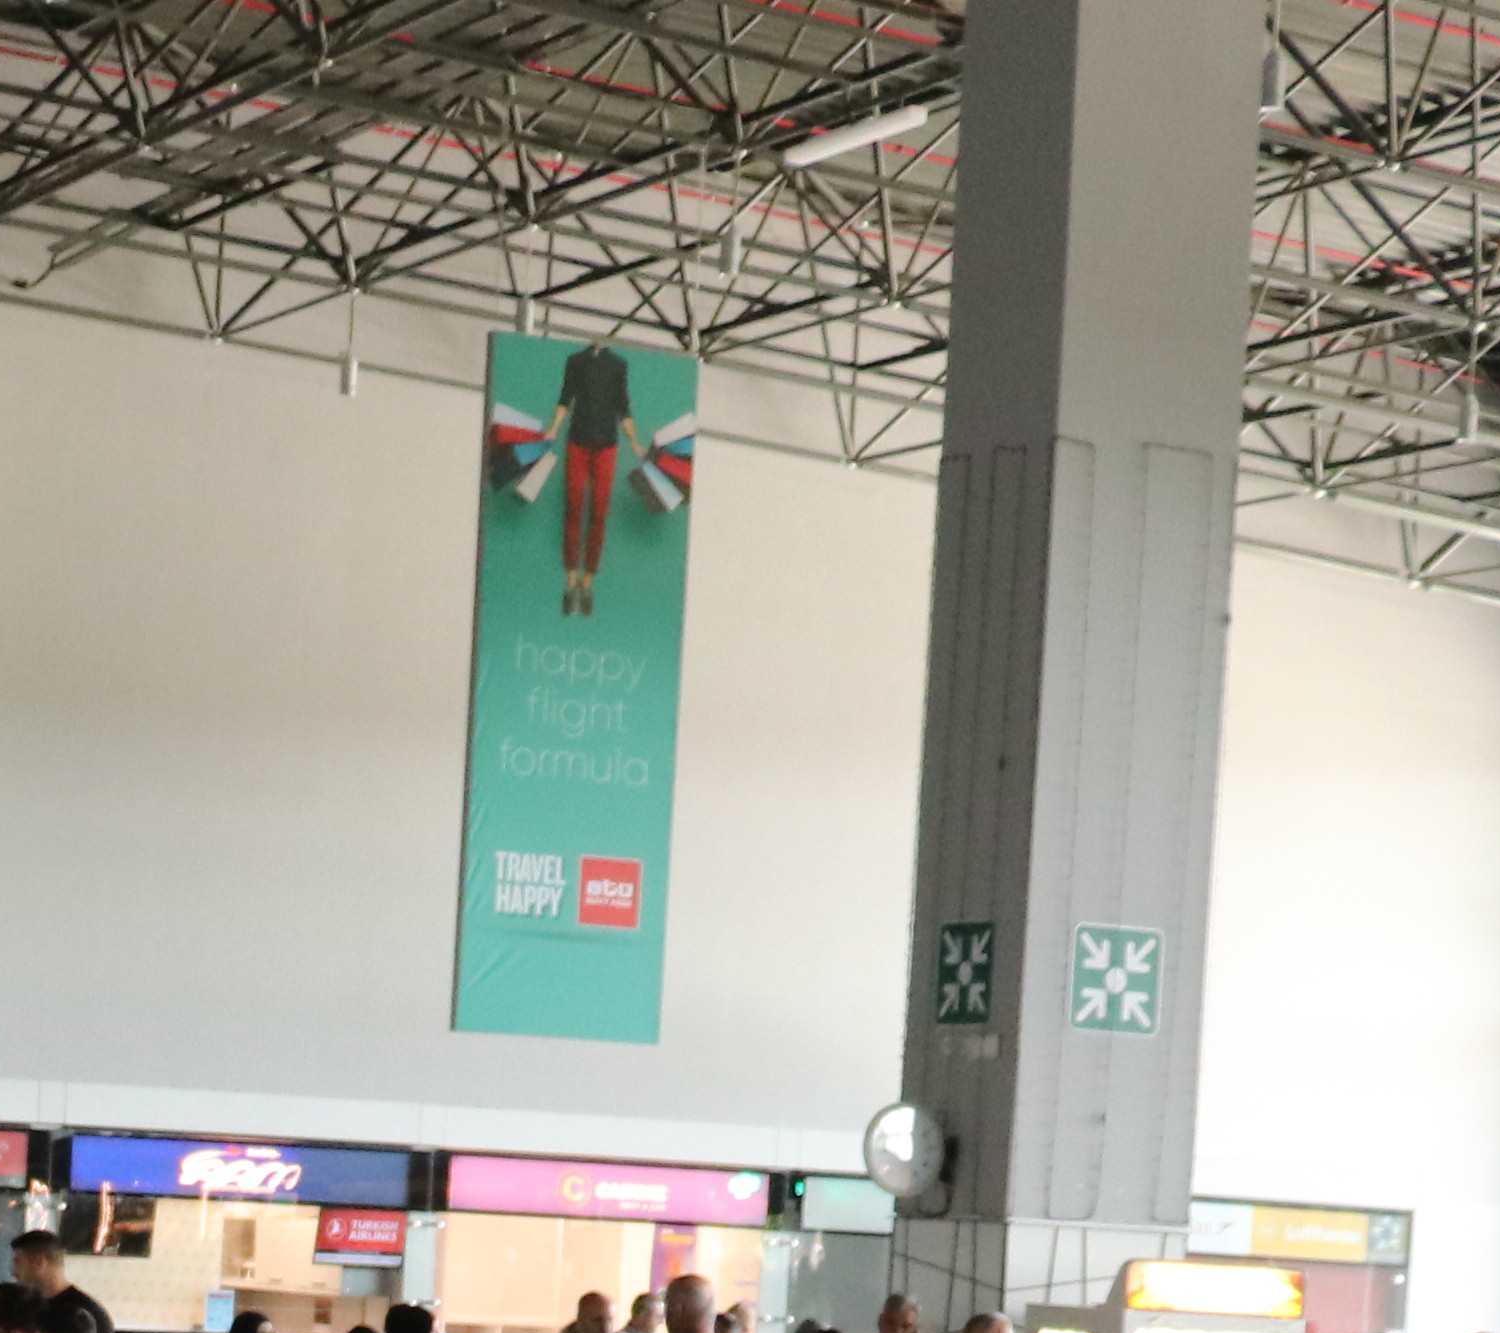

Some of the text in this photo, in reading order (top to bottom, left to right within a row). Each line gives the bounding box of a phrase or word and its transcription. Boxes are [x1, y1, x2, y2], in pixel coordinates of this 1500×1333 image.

[513, 632, 647, 694] happy
[525, 685, 628, 737] flight
[500, 736, 649, 787] formula
[495, 851, 566, 887] TRAVEL
[495, 883, 564, 917] HAPPY
